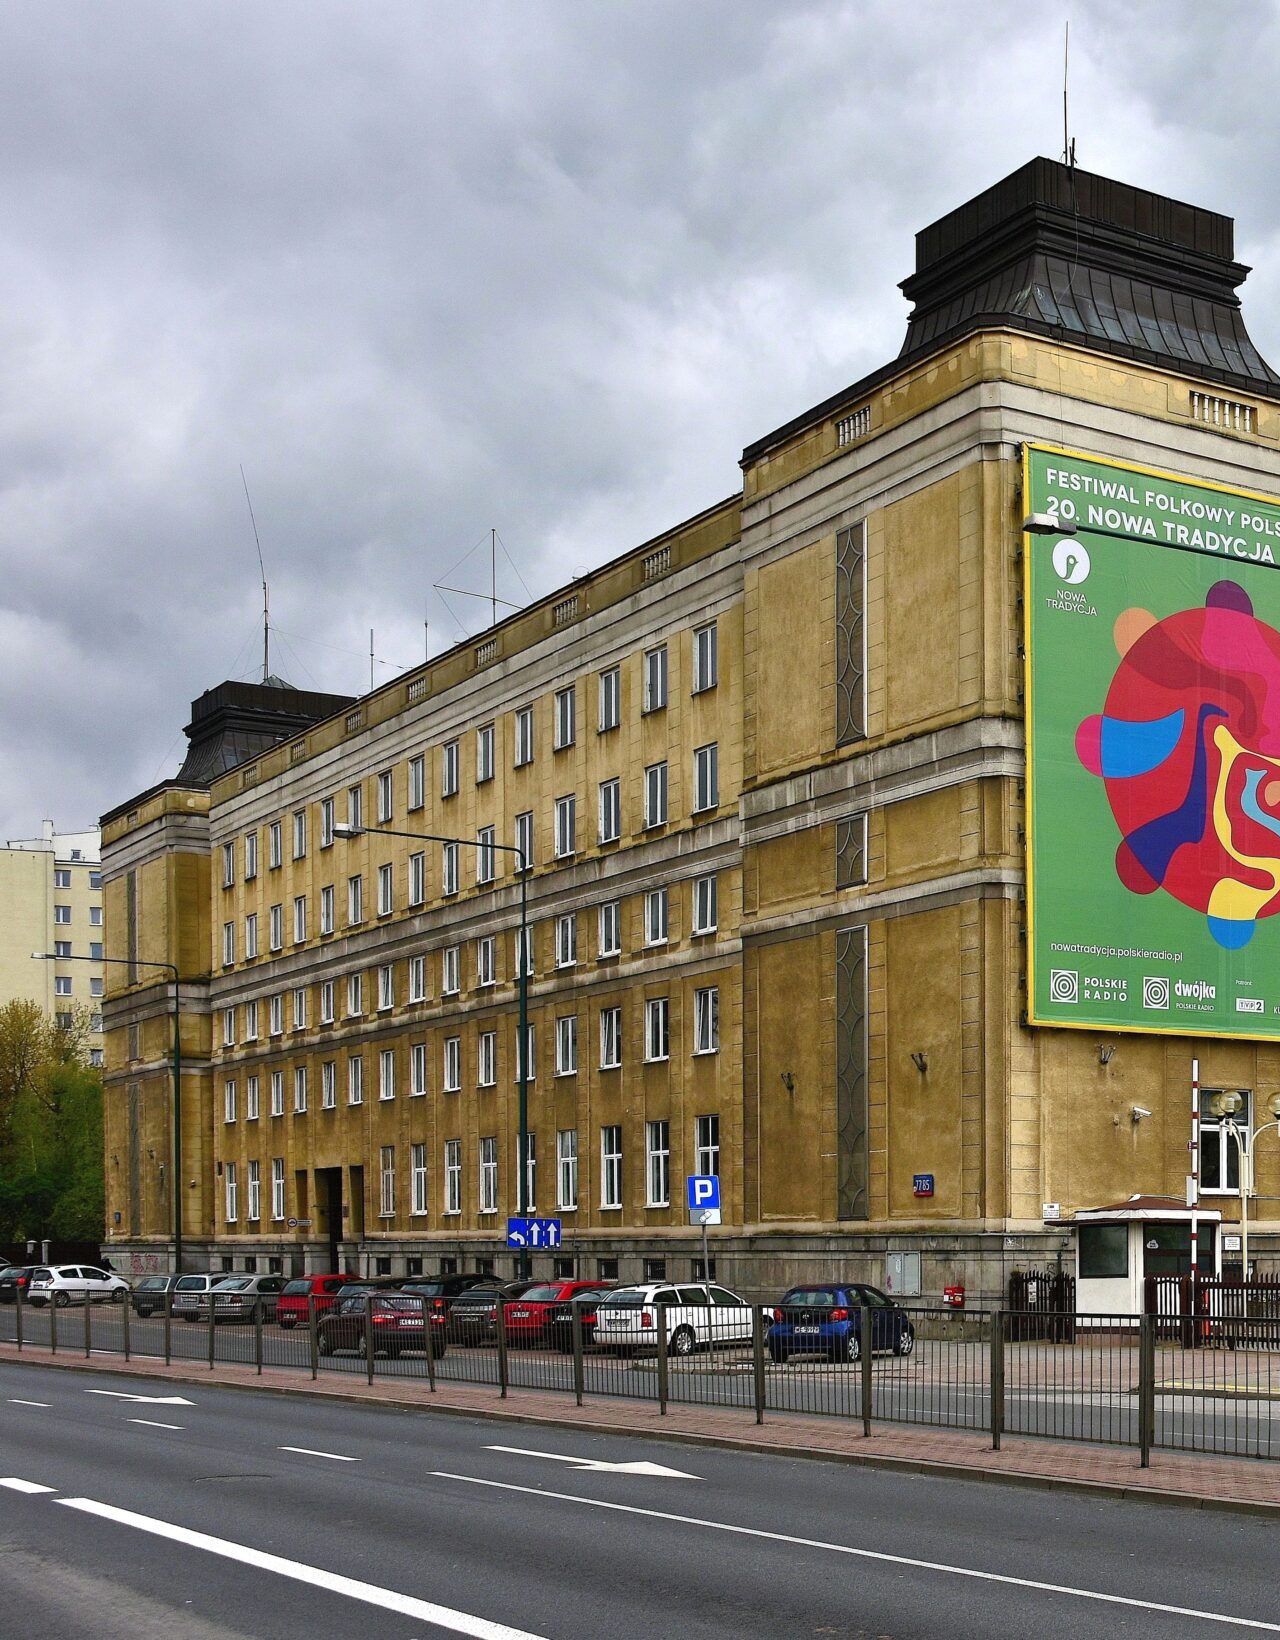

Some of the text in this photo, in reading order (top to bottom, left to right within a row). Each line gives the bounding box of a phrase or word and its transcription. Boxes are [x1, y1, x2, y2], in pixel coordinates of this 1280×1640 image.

[1046, 469, 1140, 505] FESTIWAL
[1145, 491, 1236, 527] FOLKOWY
[1045, 496, 1275, 564] 20. NOWA TRADYCJA
[1056, 590, 1087, 604] NOWA
[1046, 598, 1098, 617] TRADYCJA
[1050, 942, 1183, 963] nowatradycja.polskieradio.pl
[1084, 977, 1128, 990] POLSKIE
[1175, 979, 1216, 1002] dwójka
[1084, 989, 1128, 1002] RADIO
[1175, 1002, 1215, 1012] POLSKIE RADIO
[694, 1179, 713, 1205] P
